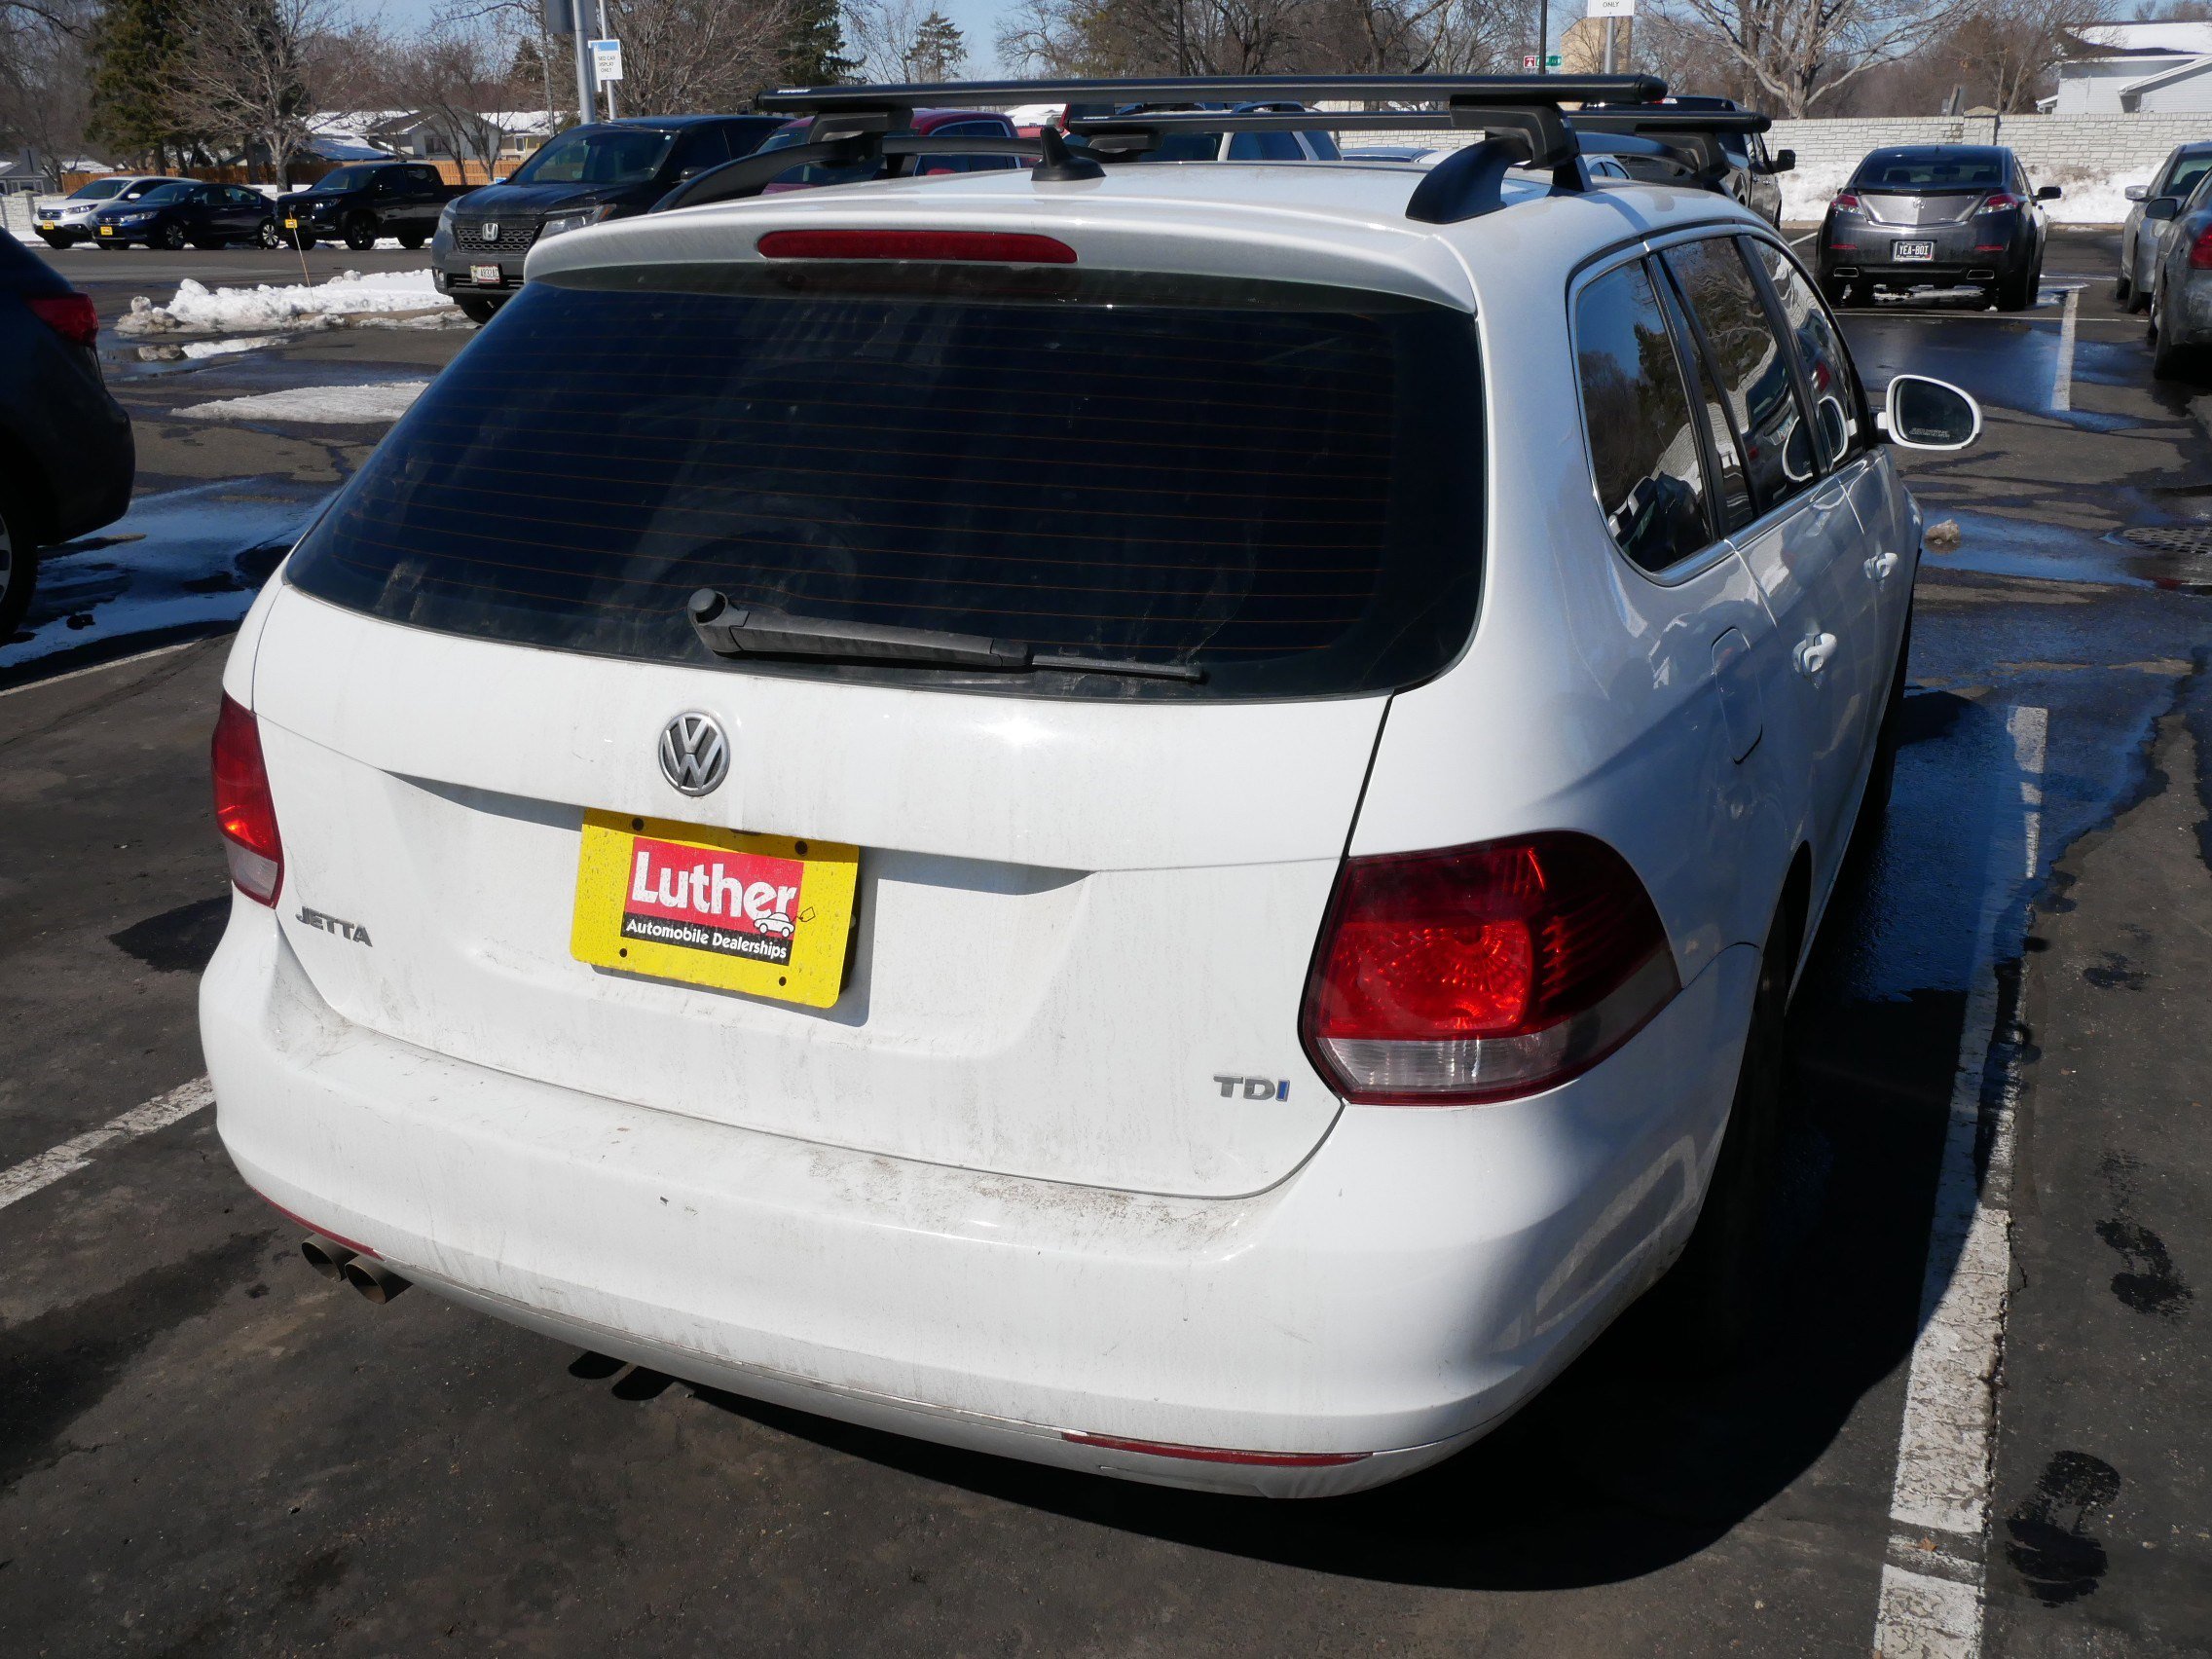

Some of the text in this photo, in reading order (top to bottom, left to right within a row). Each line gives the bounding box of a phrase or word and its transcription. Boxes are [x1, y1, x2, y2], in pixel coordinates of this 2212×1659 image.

[660, 711, 728, 795] VW
[631, 851, 797, 919] Luther
[295, 905, 373, 947] JETTA
[625, 918, 787, 959] Automobile Dealerships
[1213, 1075, 1290, 1102] TDI
